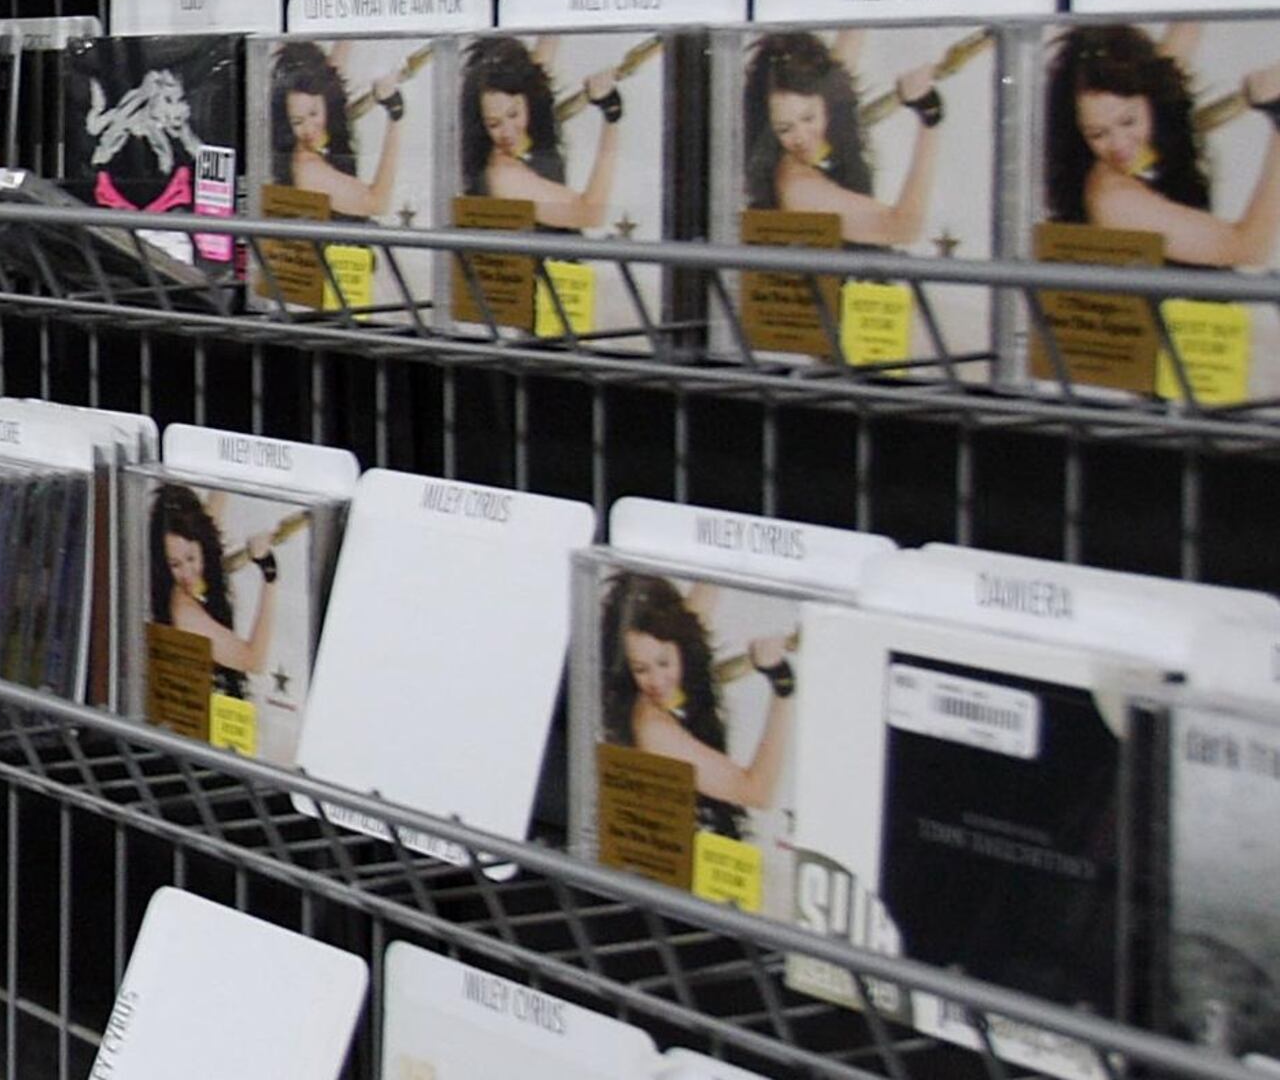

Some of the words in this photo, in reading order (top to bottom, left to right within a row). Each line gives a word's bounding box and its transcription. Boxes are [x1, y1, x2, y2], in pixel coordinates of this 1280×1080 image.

[421, 482, 459, 514] MILEY
[464, 489, 513, 523] CYRUS
[696, 518, 744, 550] MILEY
[750, 521, 806, 560] CYRUS
[463, 970, 507, 1013] MILEY
[512, 986, 565, 1035] CYRUS
